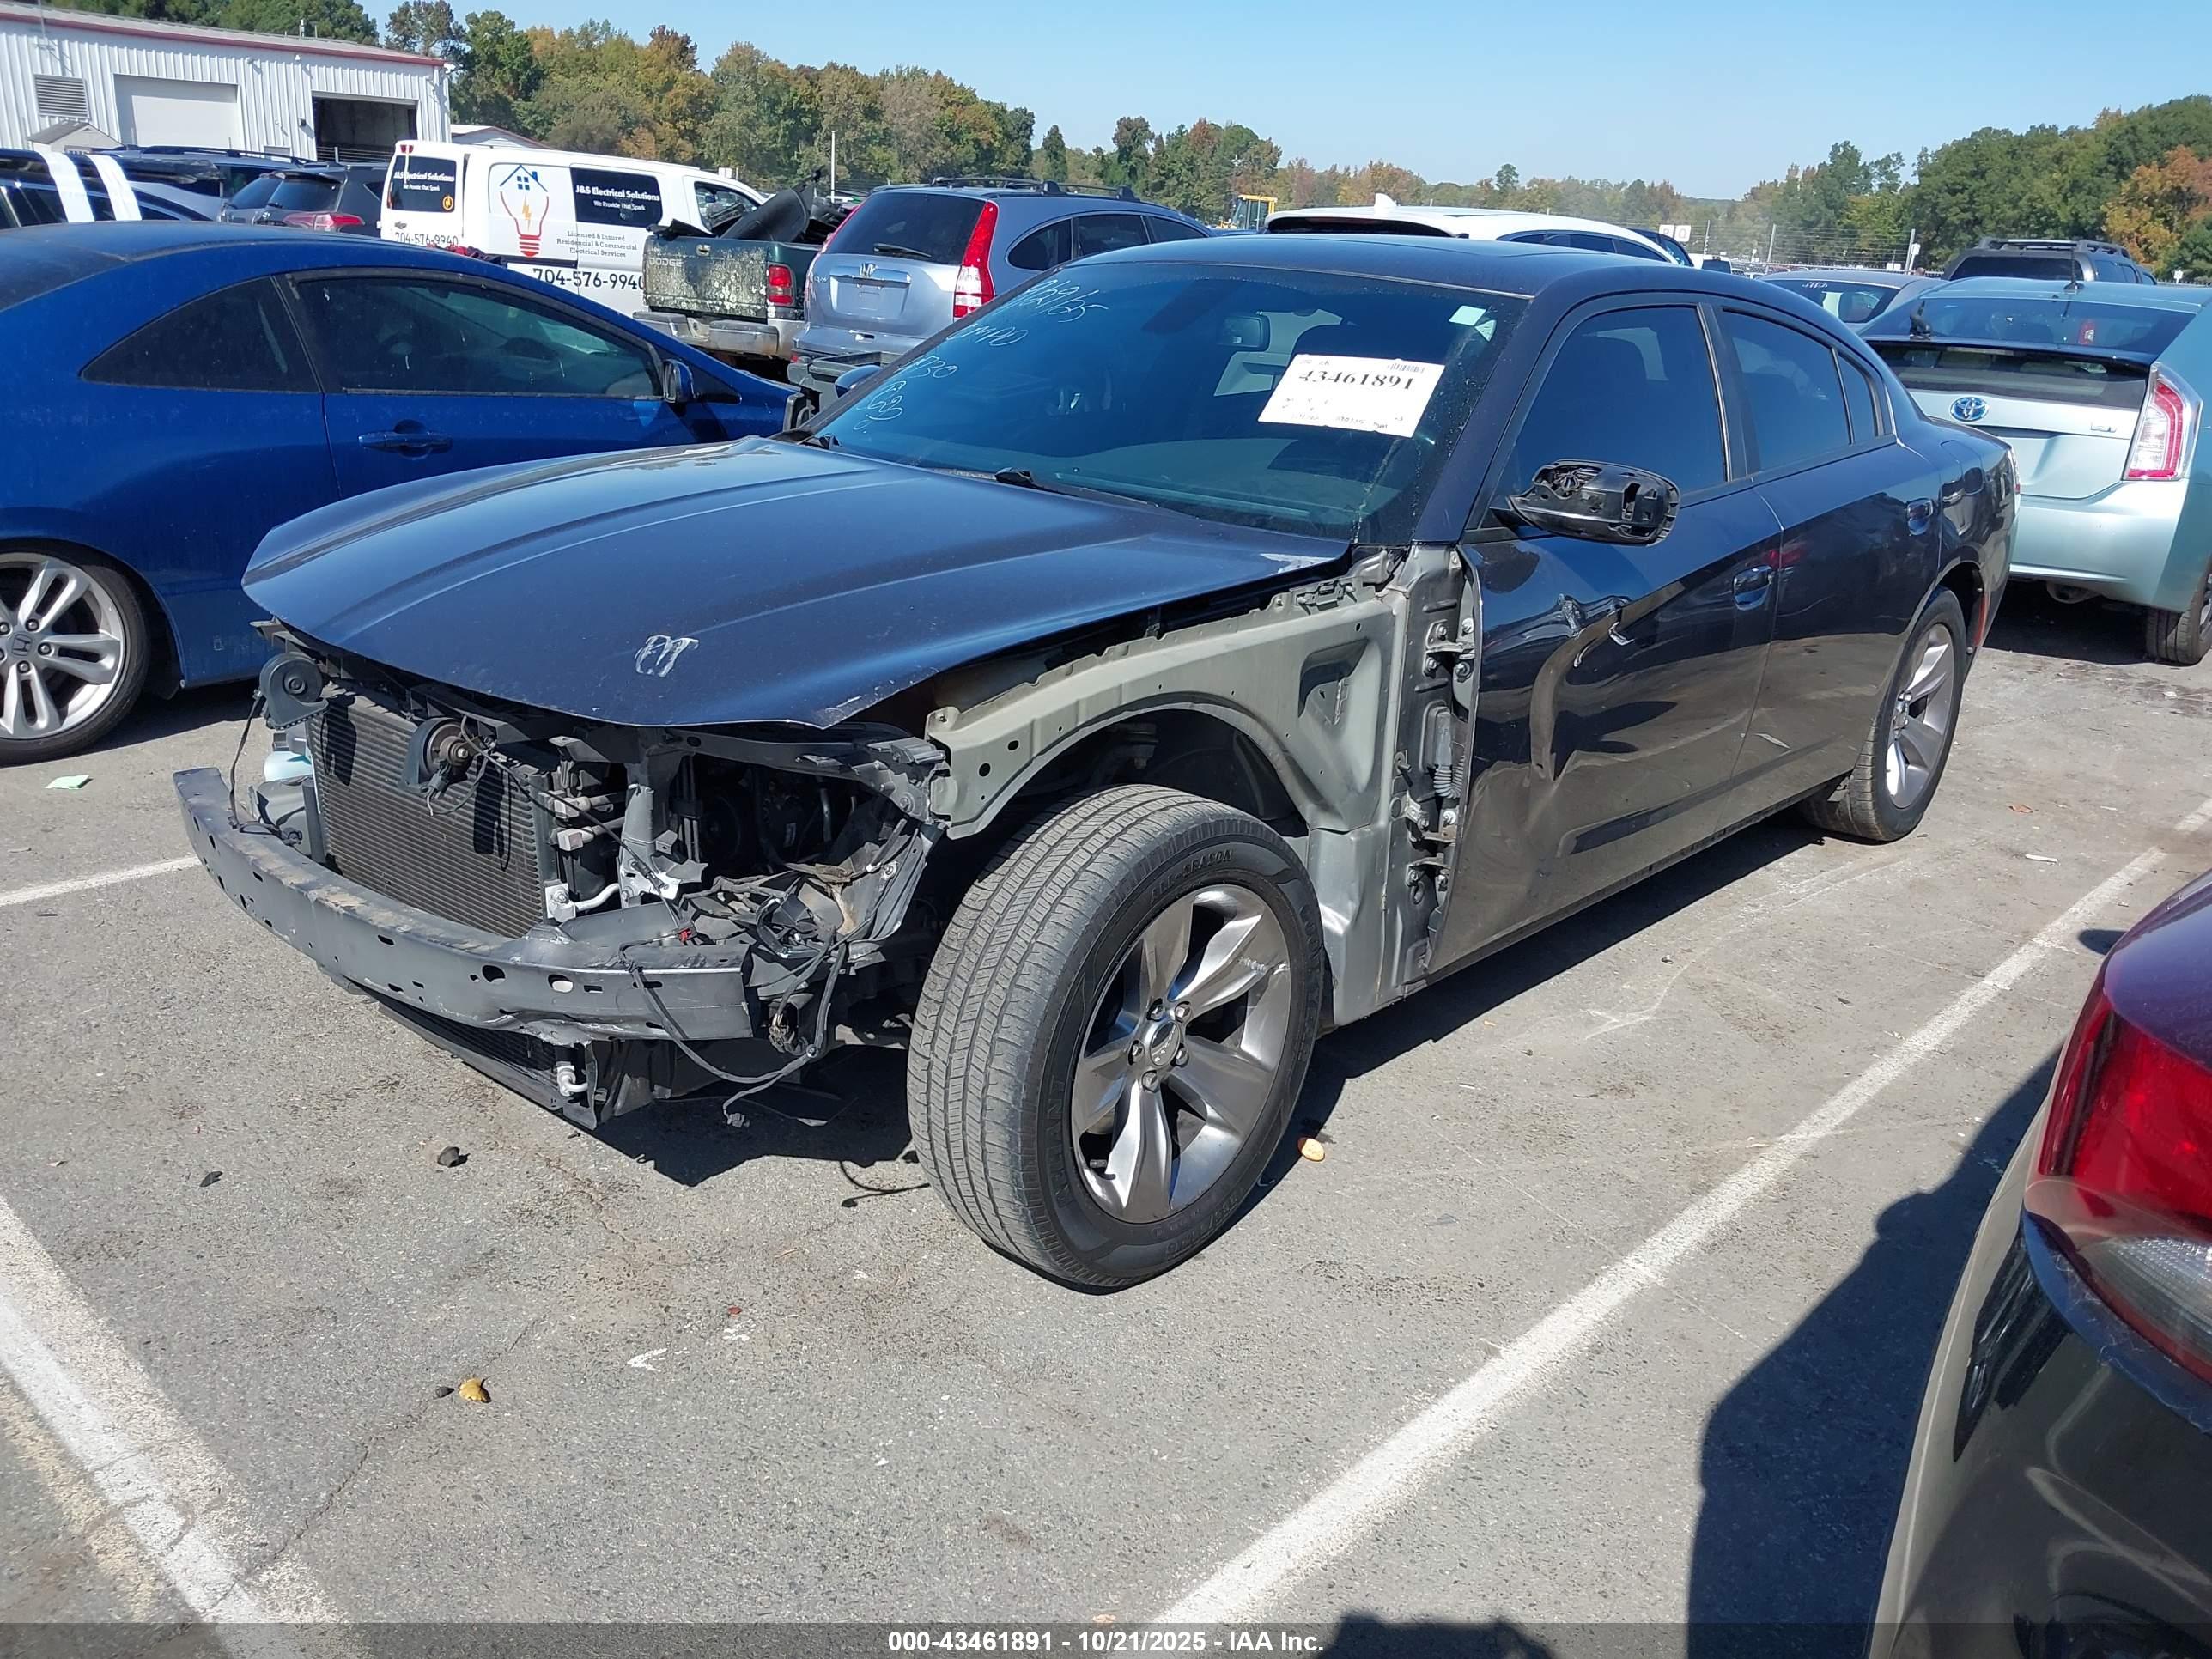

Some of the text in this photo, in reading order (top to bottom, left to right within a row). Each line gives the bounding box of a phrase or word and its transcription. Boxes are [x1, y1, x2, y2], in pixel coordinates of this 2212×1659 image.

[575, 185, 660, 201] J&S Electrical Solutions
[599, 241, 637, 250] Commercial
[569, 247, 599, 256] Electrical
[648, 258, 683, 267] DODGE
[1297, 369, 1414, 391] 43461891
